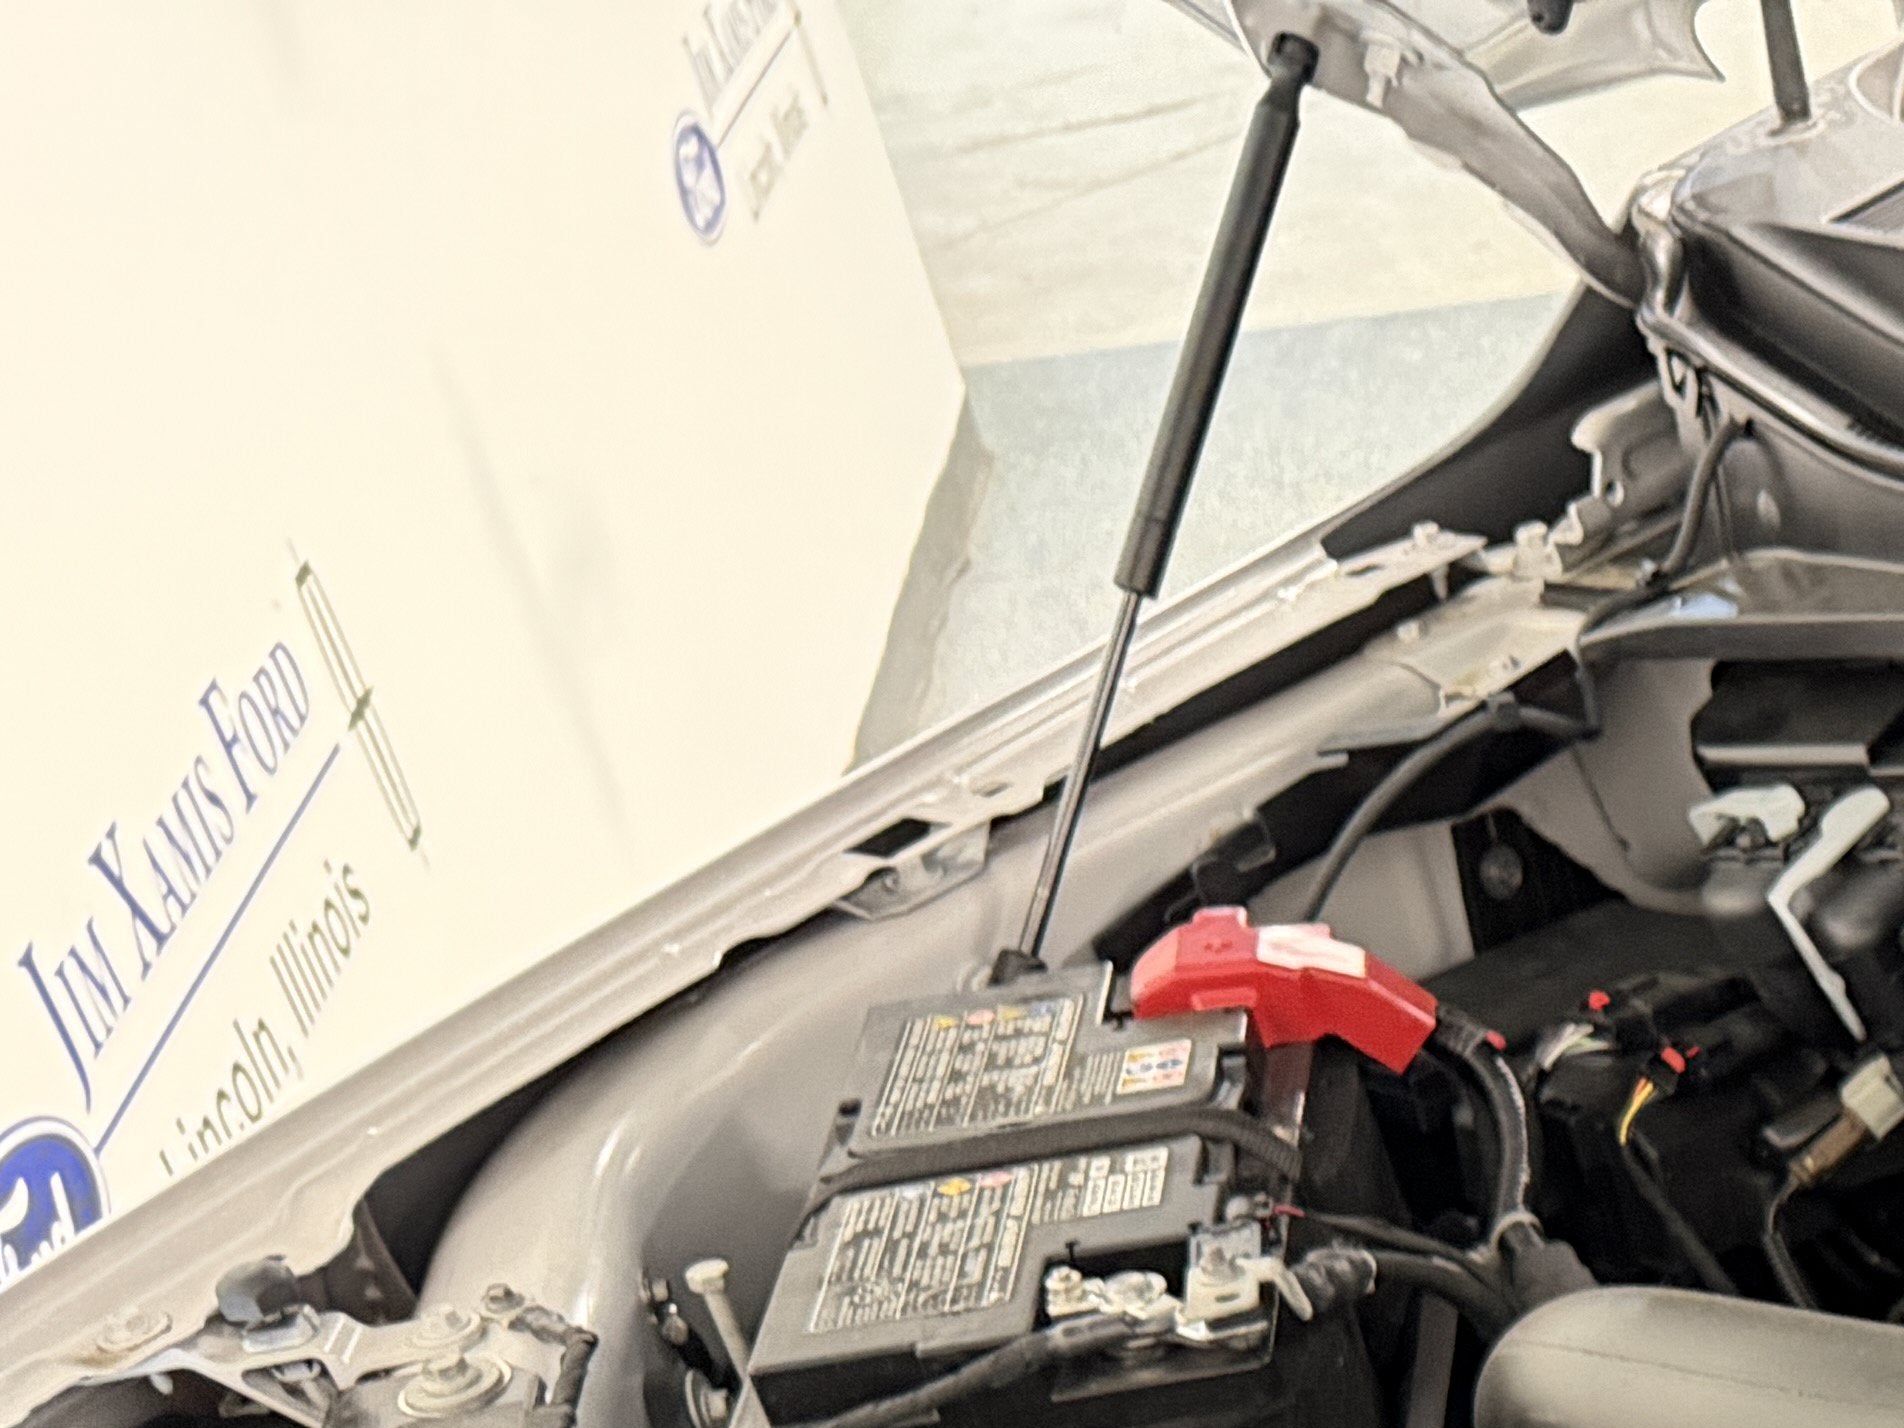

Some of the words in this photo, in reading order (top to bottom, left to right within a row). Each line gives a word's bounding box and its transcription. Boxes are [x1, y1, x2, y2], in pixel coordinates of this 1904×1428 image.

[17, 915, 133, 1113] JIM
[198, 640, 311, 818] FORD
[268, 857, 374, 1040] Illinois
